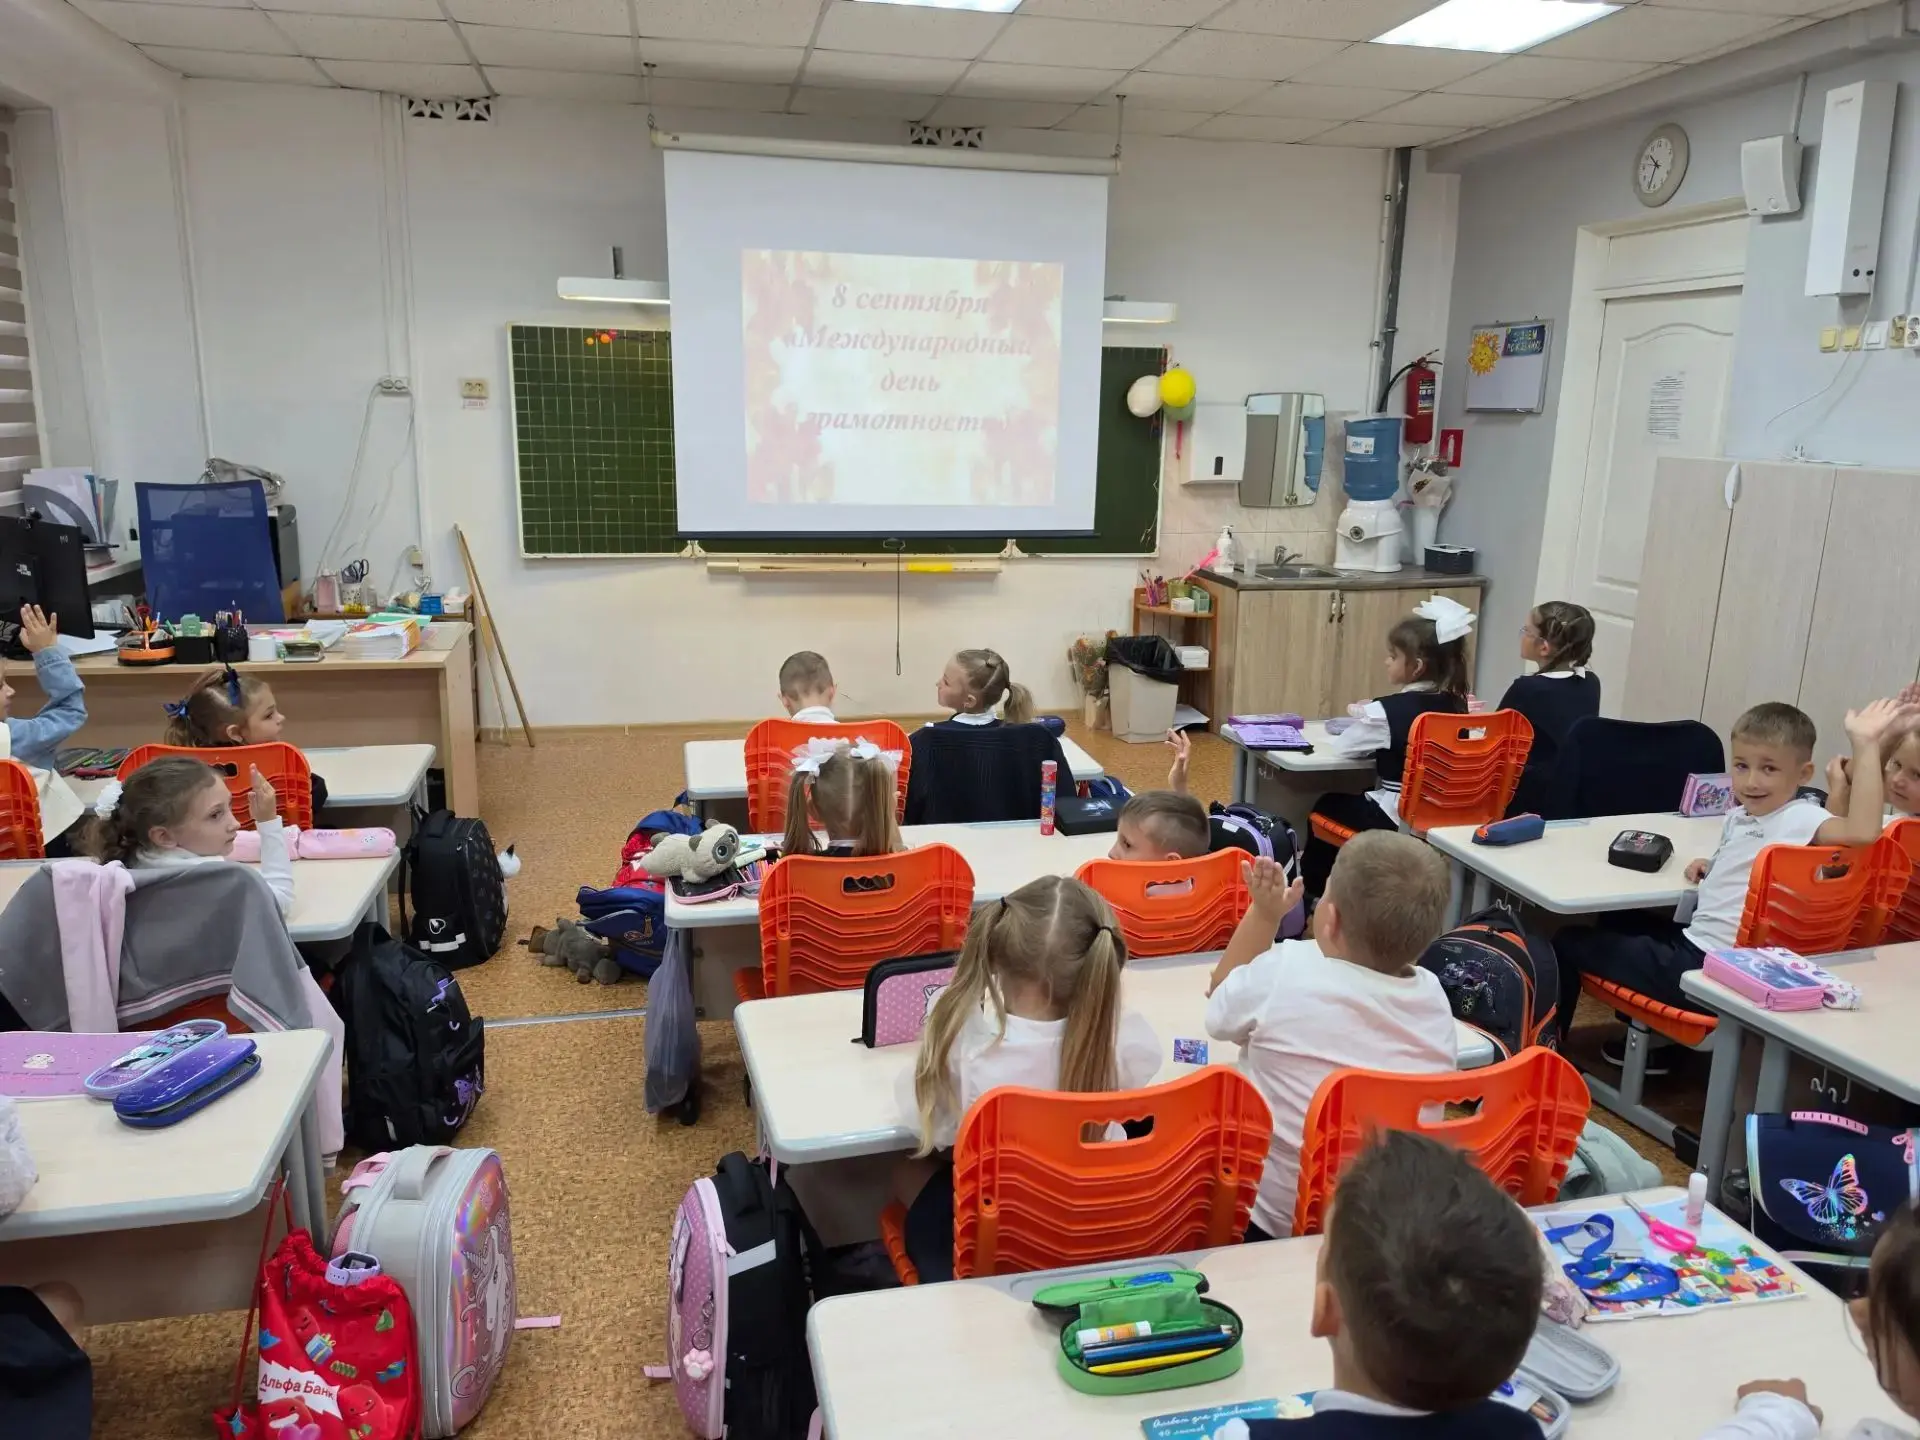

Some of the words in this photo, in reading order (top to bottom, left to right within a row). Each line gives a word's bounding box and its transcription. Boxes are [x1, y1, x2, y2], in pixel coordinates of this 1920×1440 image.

[832, 284, 848, 309] 8
[856, 290, 988, 317] сентября
[880, 370, 941, 393] день
[260, 1373, 302, 1394] Альфа
[303, 1380, 335, 1401] Банк
